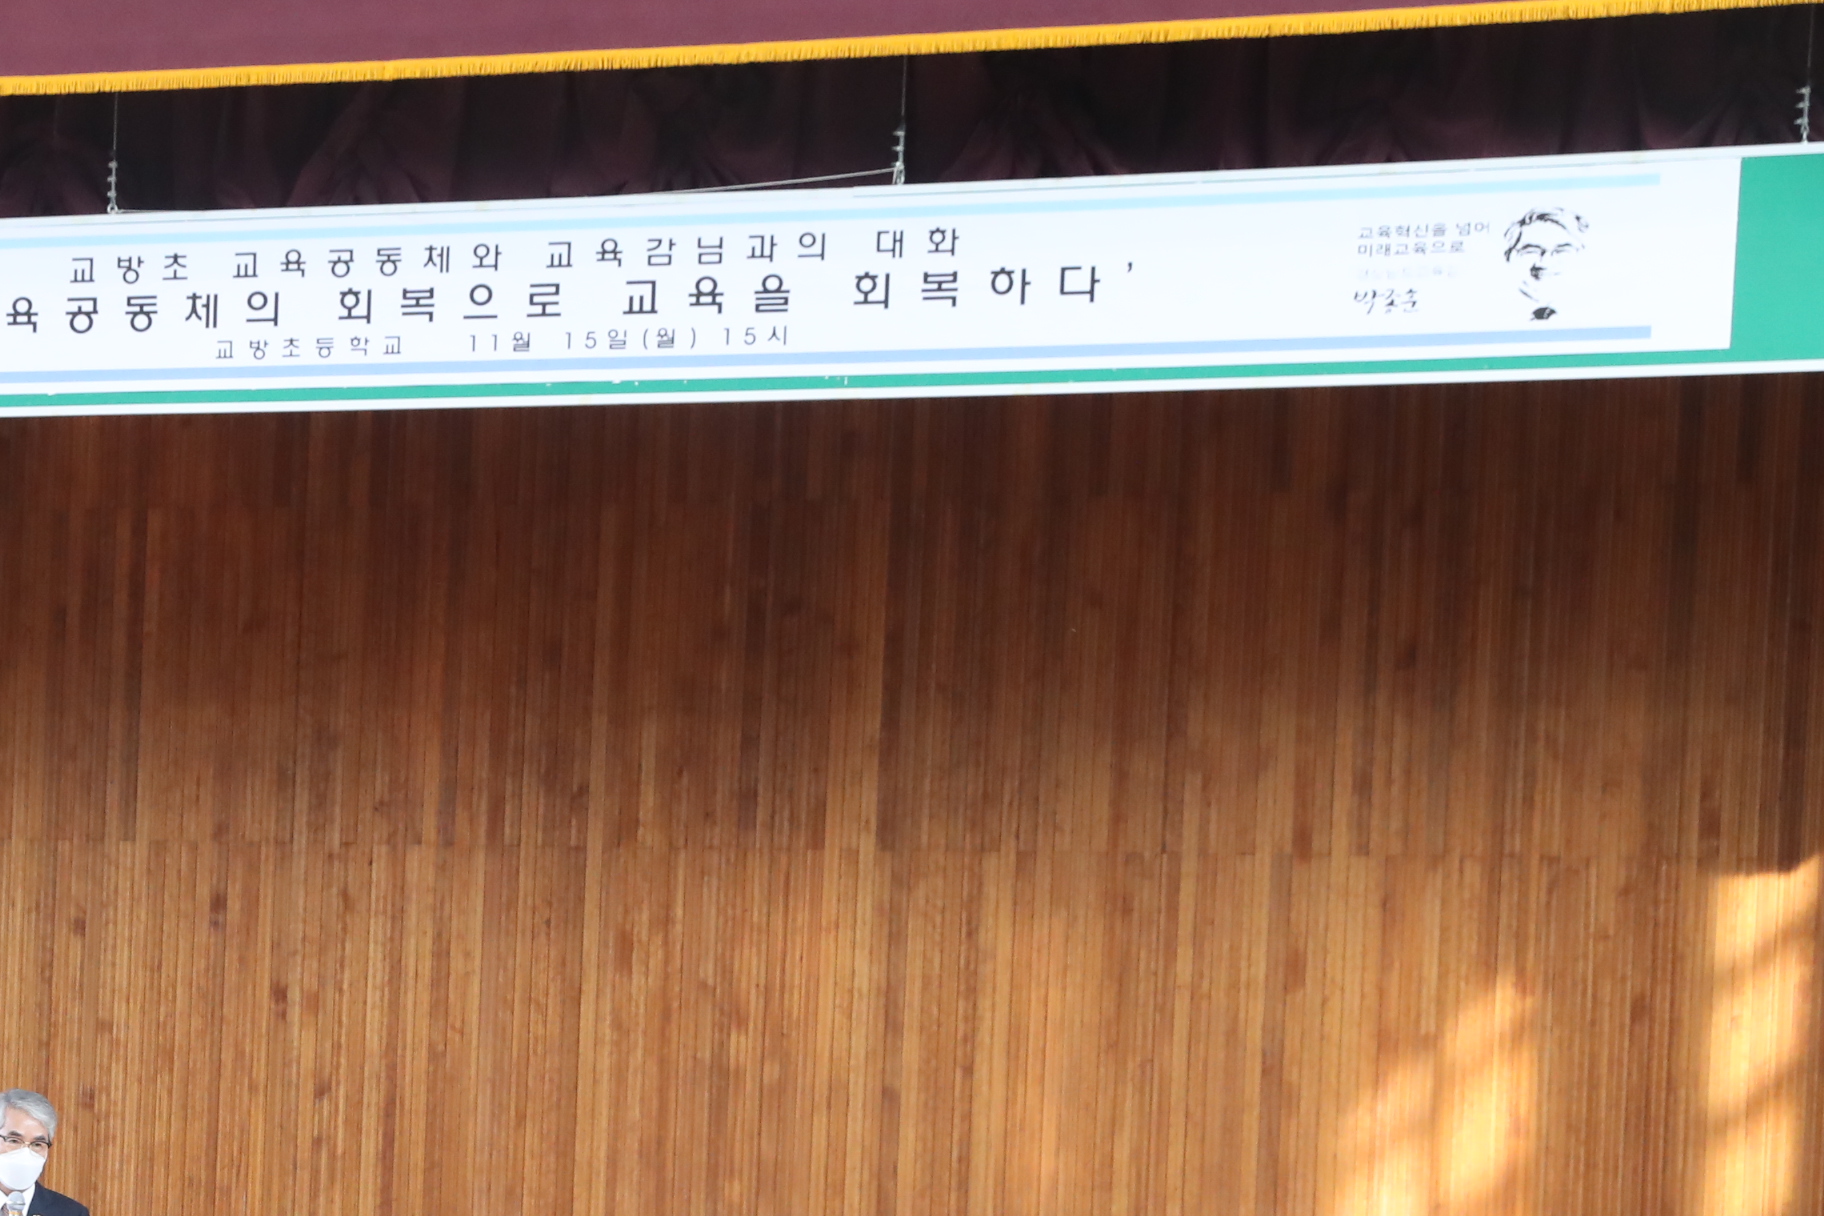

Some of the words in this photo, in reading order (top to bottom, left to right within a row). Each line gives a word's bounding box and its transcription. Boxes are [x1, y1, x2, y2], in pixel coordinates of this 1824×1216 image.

[1358, 222, 1448, 239] 교육혁신을
[1456, 221, 1490, 237] 넘어
[70, 253, 188, 285] 교방초
[232, 243, 502, 279] 교육공동체와
[545, 231, 827, 269] 교육감님과의
[876, 226, 960, 259] 대화
[1358, 240, 1466, 257] 미래교육으로
[337, 281, 563, 324] 회복으로
[622, 273, 791, 316] 교육을
[215, 335, 402, 361] 교방초등학교
[470, 331, 531, 353] 11월
[724, 325, 788, 346] 15시
